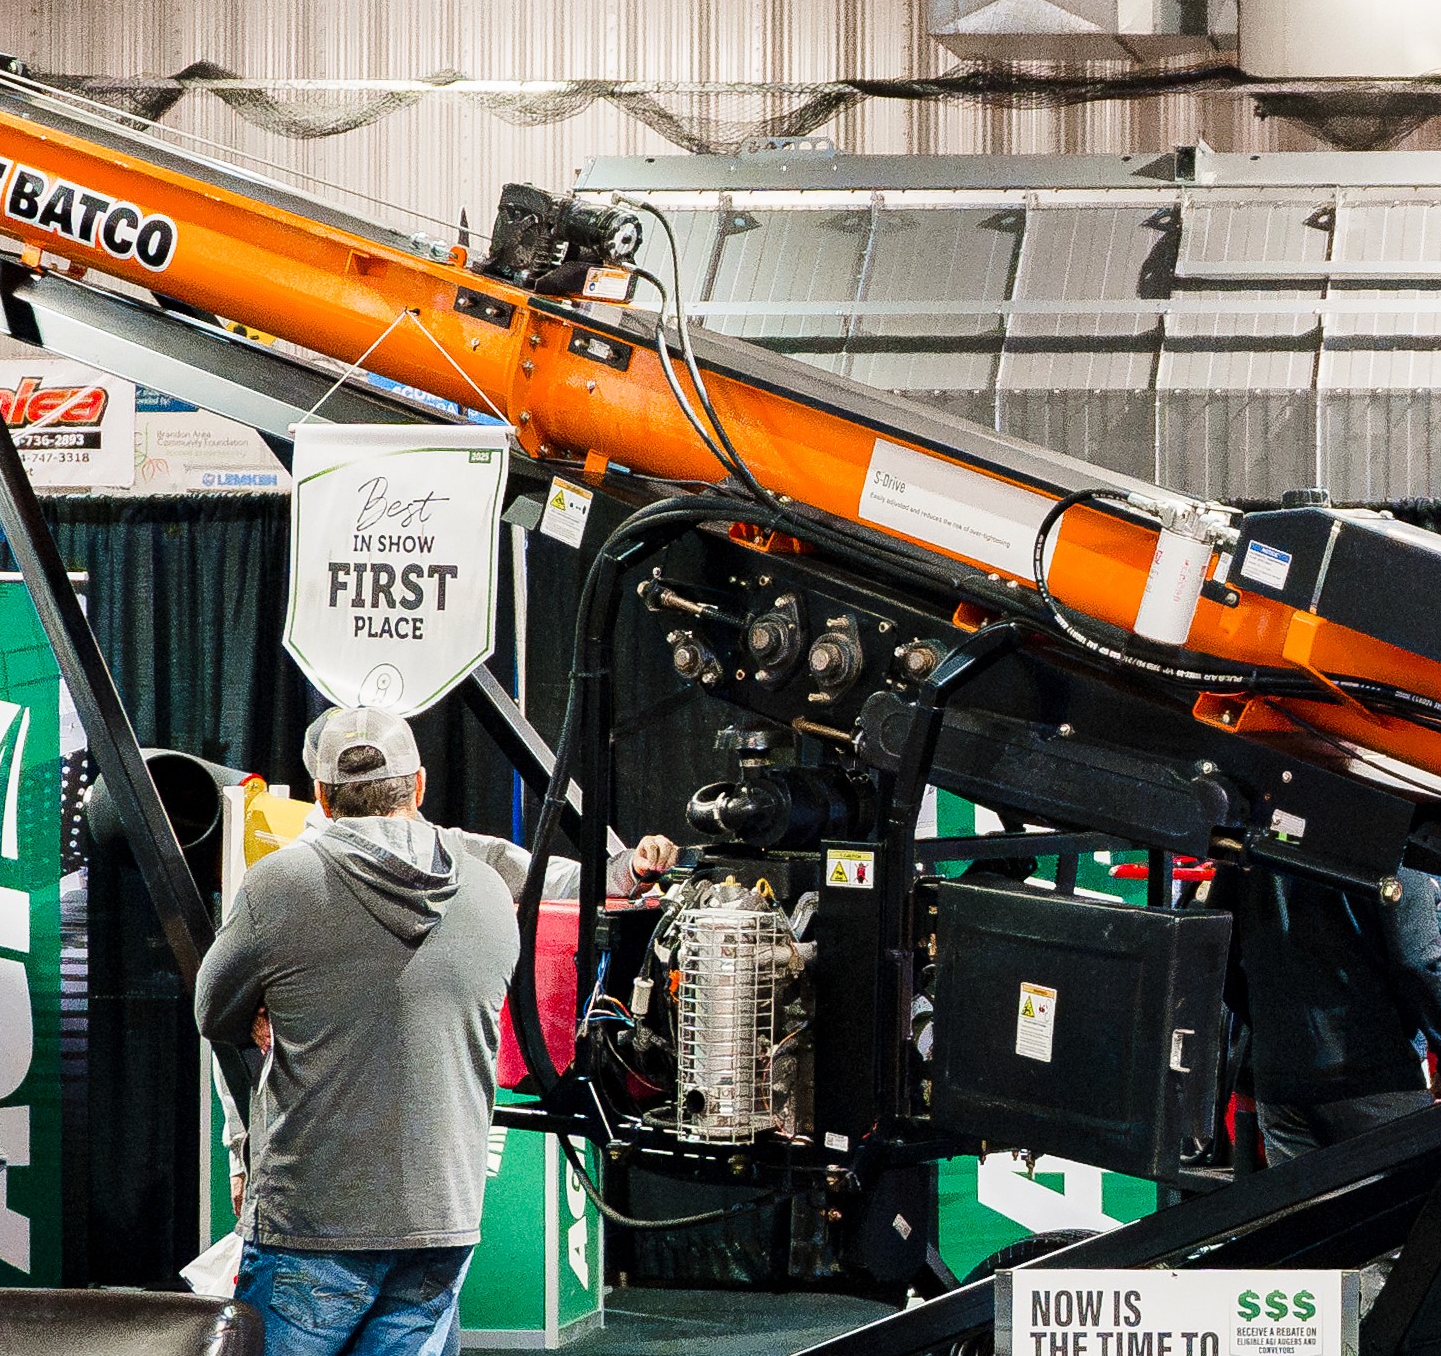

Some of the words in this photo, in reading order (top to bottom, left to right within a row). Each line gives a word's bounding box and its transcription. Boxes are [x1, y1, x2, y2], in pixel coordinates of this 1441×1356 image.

[8, 169, 175, 270] BATCO
[873, 470, 906, 494] S-Drive
[356, 476, 451, 532] Best
[353, 534, 372, 552] IN
[378, 534, 435, 554] SHOW
[328, 561, 459, 612] FIRST
[353, 615, 425, 640] PLACE
[1031, 1290, 1104, 1327] NOW
[1113, 1290, 1142, 1327] IS
[1236, 1327, 1268, 1337] RECEIVE
[1269, 1327, 1275, 1337] A
[1276, 1327, 1304, 1337] REBATE
[1306, 1327, 1317, 1337] ON
[1237, 1338, 1264, 1346] ELIGIBLE
[1303, 1338, 1316, 1346] AND
[1258, 1346, 1295, 1355] CONVEYORS
